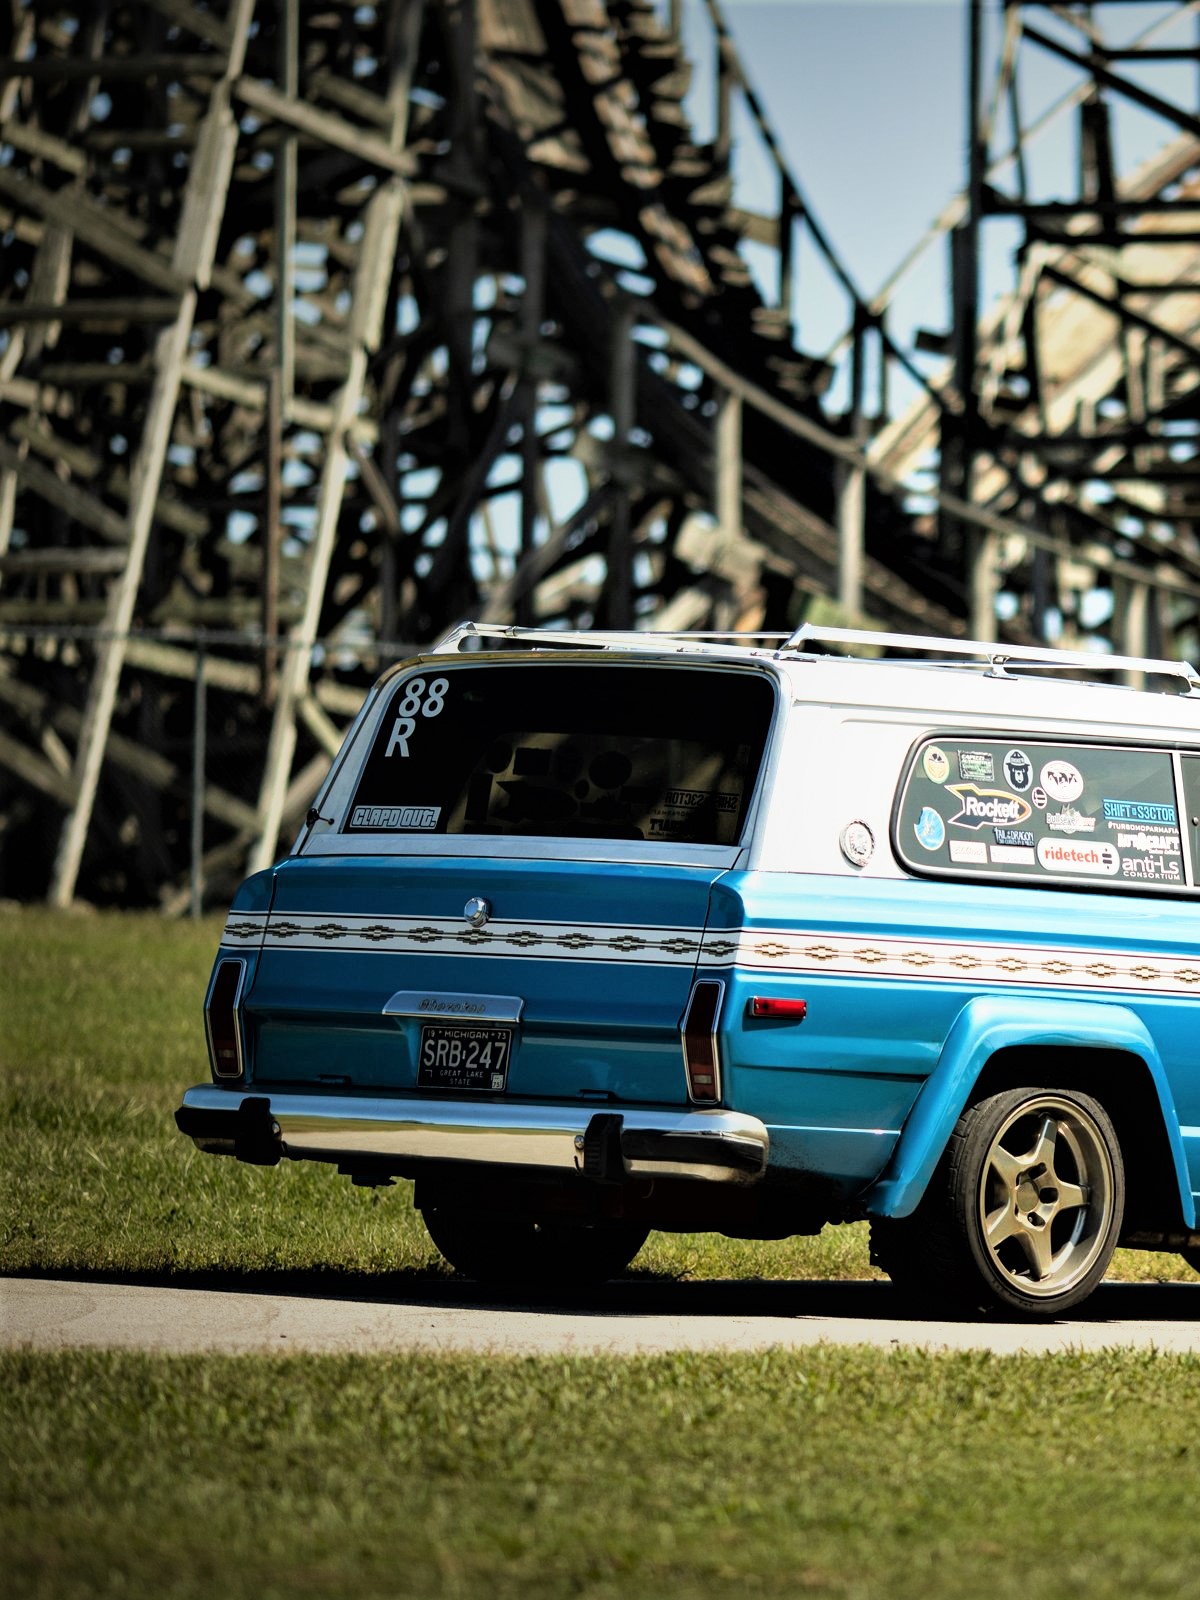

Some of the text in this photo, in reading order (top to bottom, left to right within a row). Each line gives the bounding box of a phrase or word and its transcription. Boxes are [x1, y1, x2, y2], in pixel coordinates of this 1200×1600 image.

[398, 677, 450, 718] 88
[384, 717, 416, 758] R
[966, 796, 1020, 820] Rockett
[1103, 802, 1176, 822] SHIFT S3CTOR
[351, 808, 401, 827] CLAPD
[1107, 820, 1180, 835] #TURBOMOPARMAFIA
[1044, 846, 1099, 863] ridetech
[1123, 870, 1180, 880] CONSORTIUM
[444, 1030, 489, 1039] MICHIGAN
[439, 1069, 484, 1079] GREAT LAKE
[449, 1078, 471, 1086] STATE
